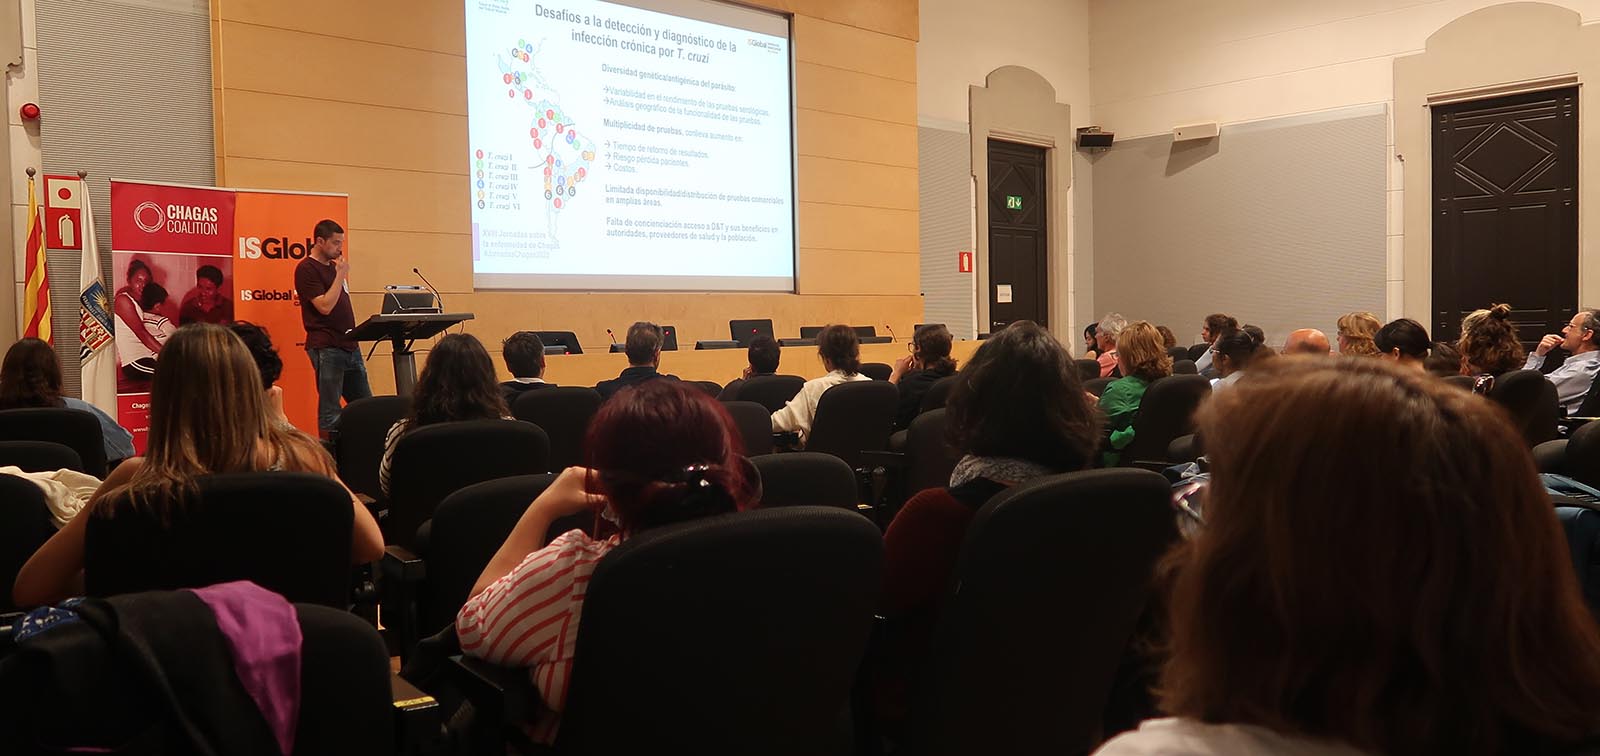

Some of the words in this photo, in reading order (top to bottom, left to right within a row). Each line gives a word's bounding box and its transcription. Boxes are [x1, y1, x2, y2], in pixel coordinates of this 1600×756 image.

[584, 16, 590, 25] a
[593, 15, 602, 28] la
[605, 18, 652, 37] detección
[654, 29, 660, 40] y
[662, 29, 715, 49] diagnóstico
[717, 39, 727, 51] de
[729, 41, 737, 53] la
[571, 29, 618, 48] infección
[620, 40, 656, 55] crónica
[659, 46, 674, 58] por
[677, 48, 686, 60] T.
[688, 51, 710, 64] cruzi
[601, 63, 638, 77] Diversidad
[700, 79, 710, 88] del
[603, 118, 646, 132] Multiplicidad
[647, 123, 656, 133] de
[613, 140, 636, 153] Tiempo
[637, 144, 646, 153] de
[605, 184, 634, 195] Limitada
[167, 204, 218, 222] CHAGAS
[167, 219, 218, 236] COALITION
[606, 216, 623, 226] Falta
[624, 218, 633, 227] de
[689, 231, 697, 240] de
[239, 237, 315, 260] ISGlob
[241, 290, 292, 301] ISGlobal
[132, 402, 151, 410] Chag
